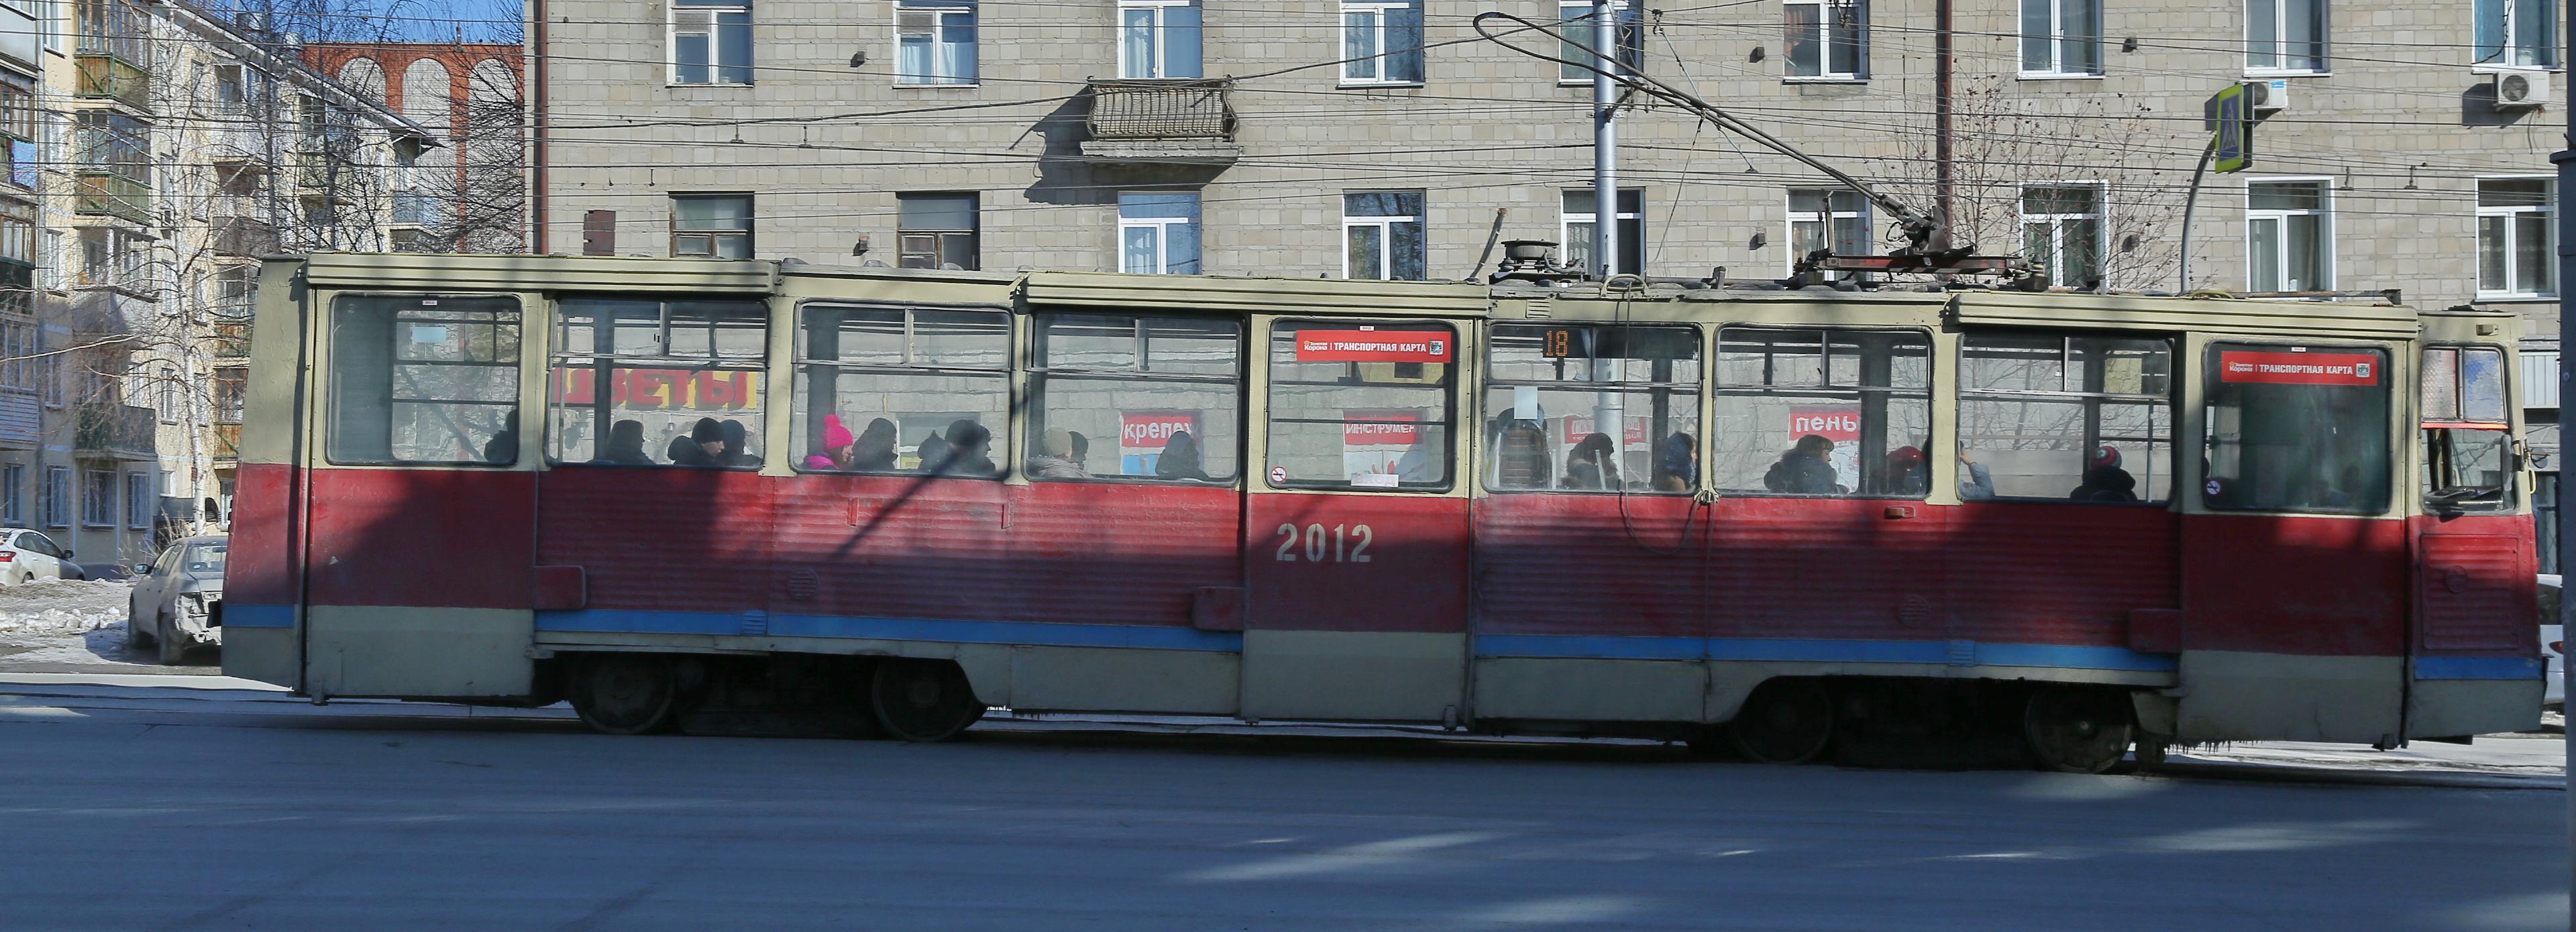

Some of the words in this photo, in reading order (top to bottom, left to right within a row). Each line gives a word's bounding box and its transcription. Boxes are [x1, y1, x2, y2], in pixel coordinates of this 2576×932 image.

[1334, 342, 1397, 352] ТРАНСПОРТНАЯ
[1400, 343, 1427, 352] КАРТА
[1546, 330, 1568, 357] 18
[2259, 364, 2324, 374] ТРАНСПОРТНАЯ
[2326, 366, 2353, 375] КАРТА
[1276, 523, 1373, 563] 2012
